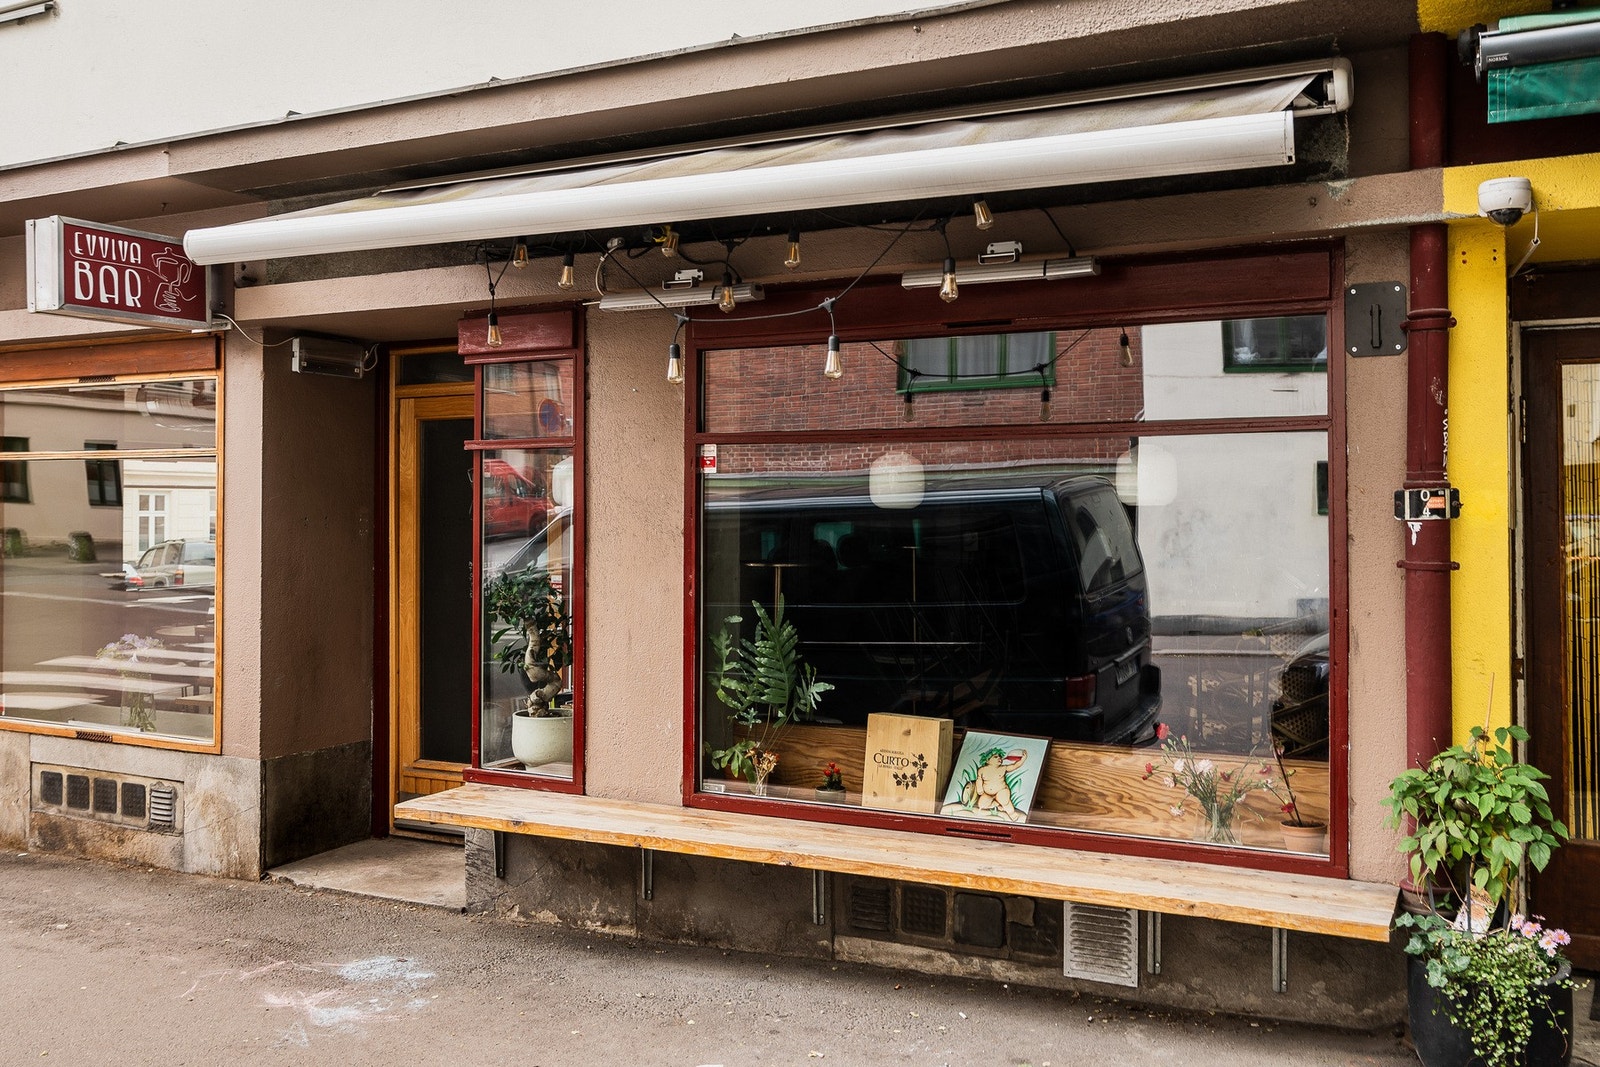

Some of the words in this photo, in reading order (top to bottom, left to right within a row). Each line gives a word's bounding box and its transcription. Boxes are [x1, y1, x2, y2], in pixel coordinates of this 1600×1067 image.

[74, 231, 142, 264] EVVIVA
[74, 260, 142, 308] BAR
[873, 752, 910, 767] CURTO
